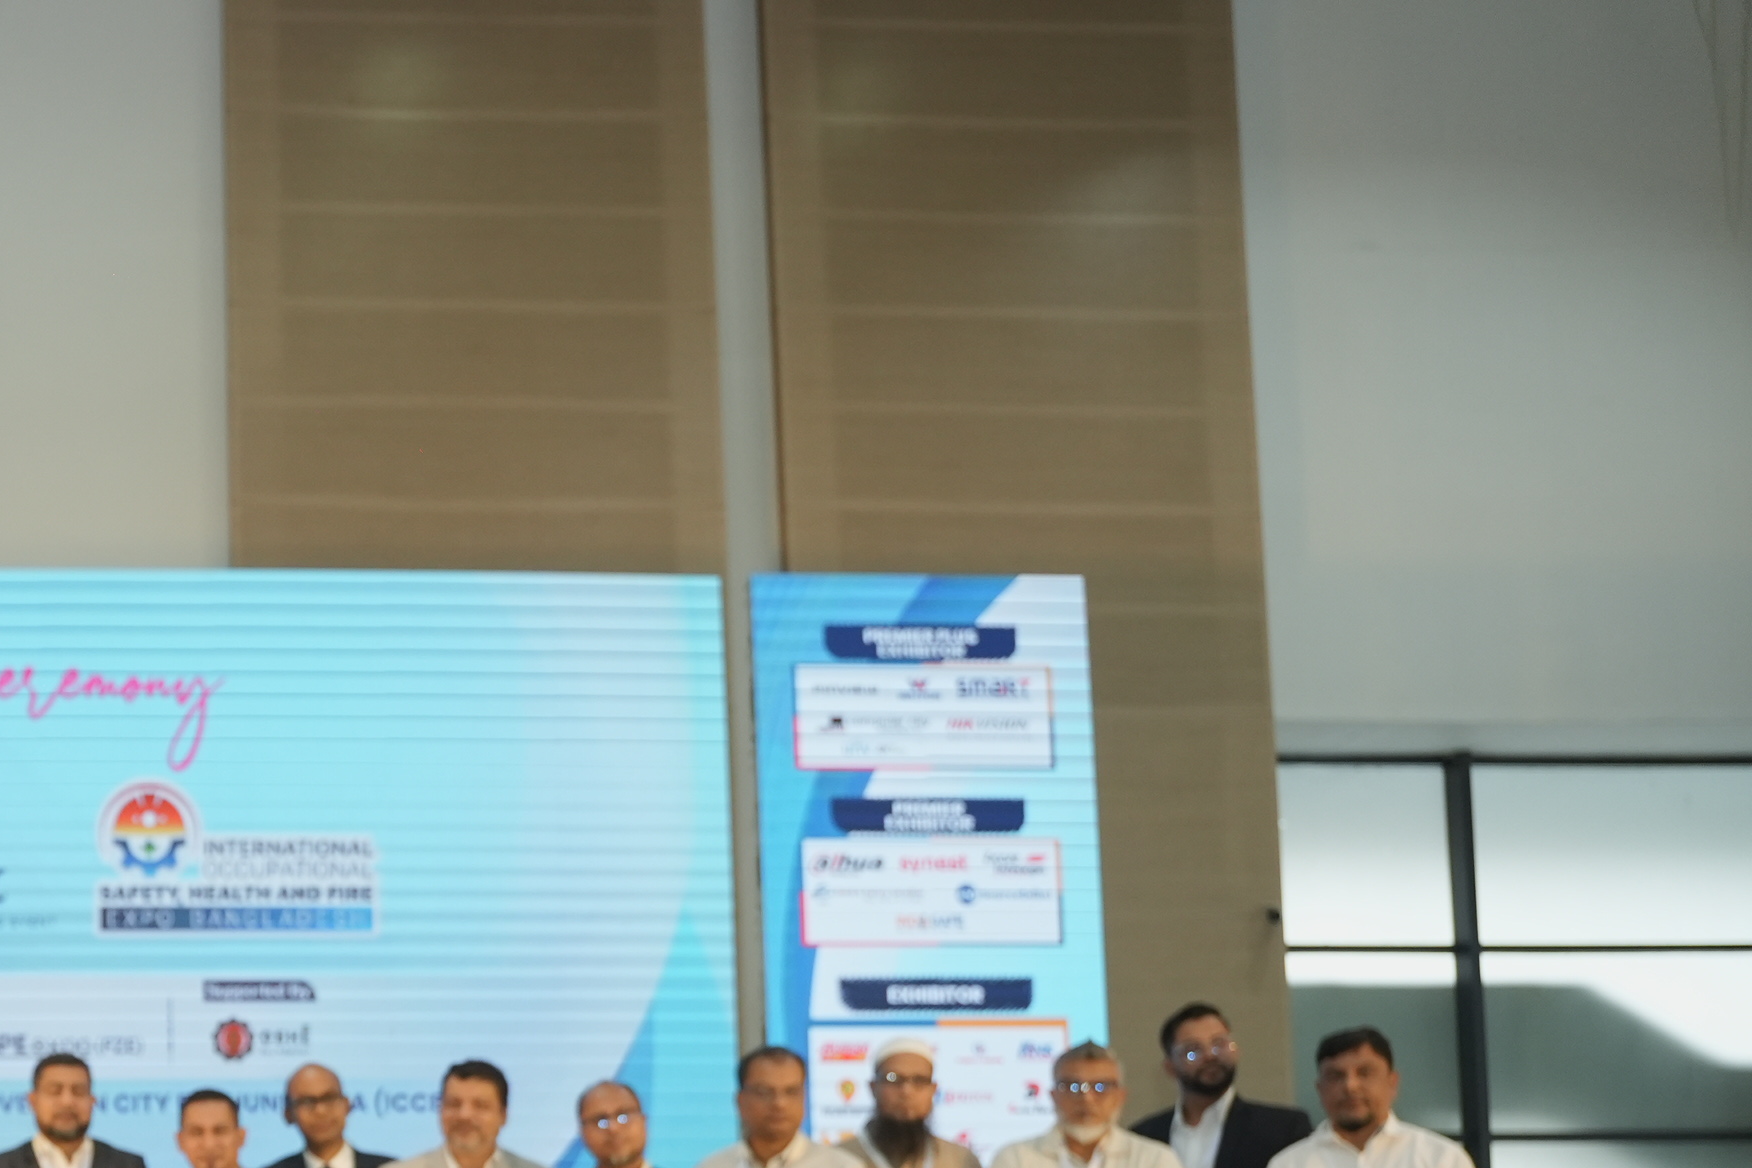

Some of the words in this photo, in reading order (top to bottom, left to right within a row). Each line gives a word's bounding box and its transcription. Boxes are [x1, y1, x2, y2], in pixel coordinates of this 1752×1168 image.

[203, 839, 372, 858] INTERNATIONAL
[187, 886, 274, 902] HEALTH
[280, 886, 321, 902] AND
[328, 886, 372, 902] FIRE
[886, 985, 986, 1006] EXHIBITOR
[113, 1092, 167, 1114] CITY
